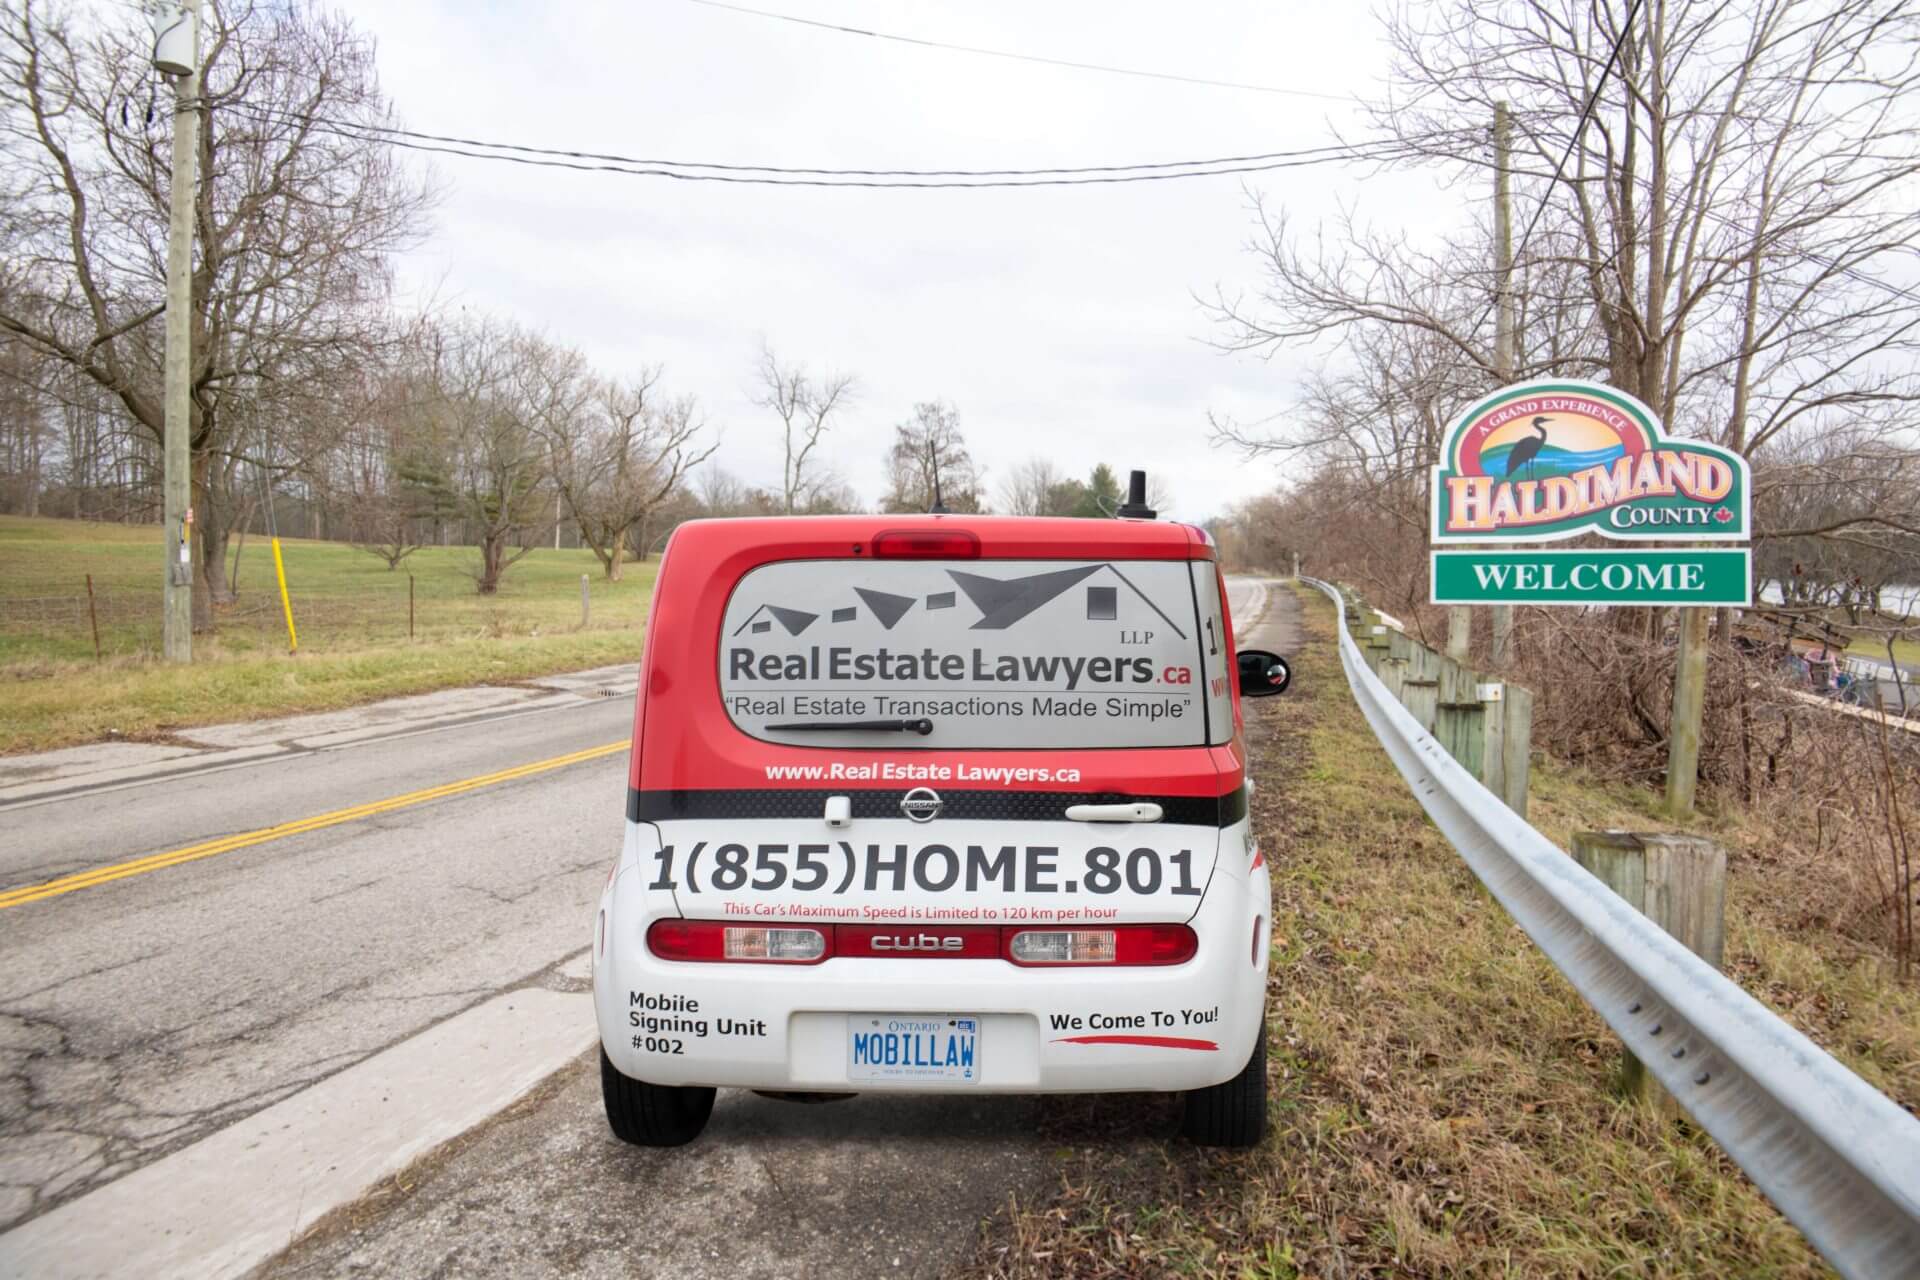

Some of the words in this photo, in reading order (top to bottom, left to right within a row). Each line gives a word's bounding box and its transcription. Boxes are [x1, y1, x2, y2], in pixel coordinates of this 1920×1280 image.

[1479, 424, 1491, 436] A
[1489, 402, 1538, 429] GRAND
[1542, 399, 1629, 432] EXPERIENCE
[1446, 450, 1733, 531] HALDIMAND
[1610, 504, 1714, 528] COUNTY
[1472, 563, 1706, 590] WELCOME
[1119, 630, 1154, 645] LLP
[794, 696, 867, 716] Estate
[873, 696, 1024, 717] Transactions
[1032, 697, 1098, 717] Made
[724, 902, 750, 915] This
[789, 904, 859, 917] Maximum
[863, 905, 907, 919] Speed
[911, 906, 922, 918] is
[926, 907, 979, 919] Limited
[983, 907, 997, 919] to
[1002, 907, 1028, 919] 120
[1031, 906, 1053, 919] km
[1057, 908, 1081, 921] per
[1084, 905, 1119, 919] hour
[871, 932, 965, 951] cube
[629, 1011, 708, 1037] Signing
[717, 1018, 767, 1036] Unit
[889, 1020, 941, 1032] ONTARIO
[1049, 1014, 1083, 1030] We
[1089, 1013, 1145, 1029] Come
[1151, 1011, 1175, 1027] To
[1181, 1006, 1219, 1025] You!
[631, 1034, 685, 1055] #002
[854, 1032, 975, 1067] MOBILLAW
